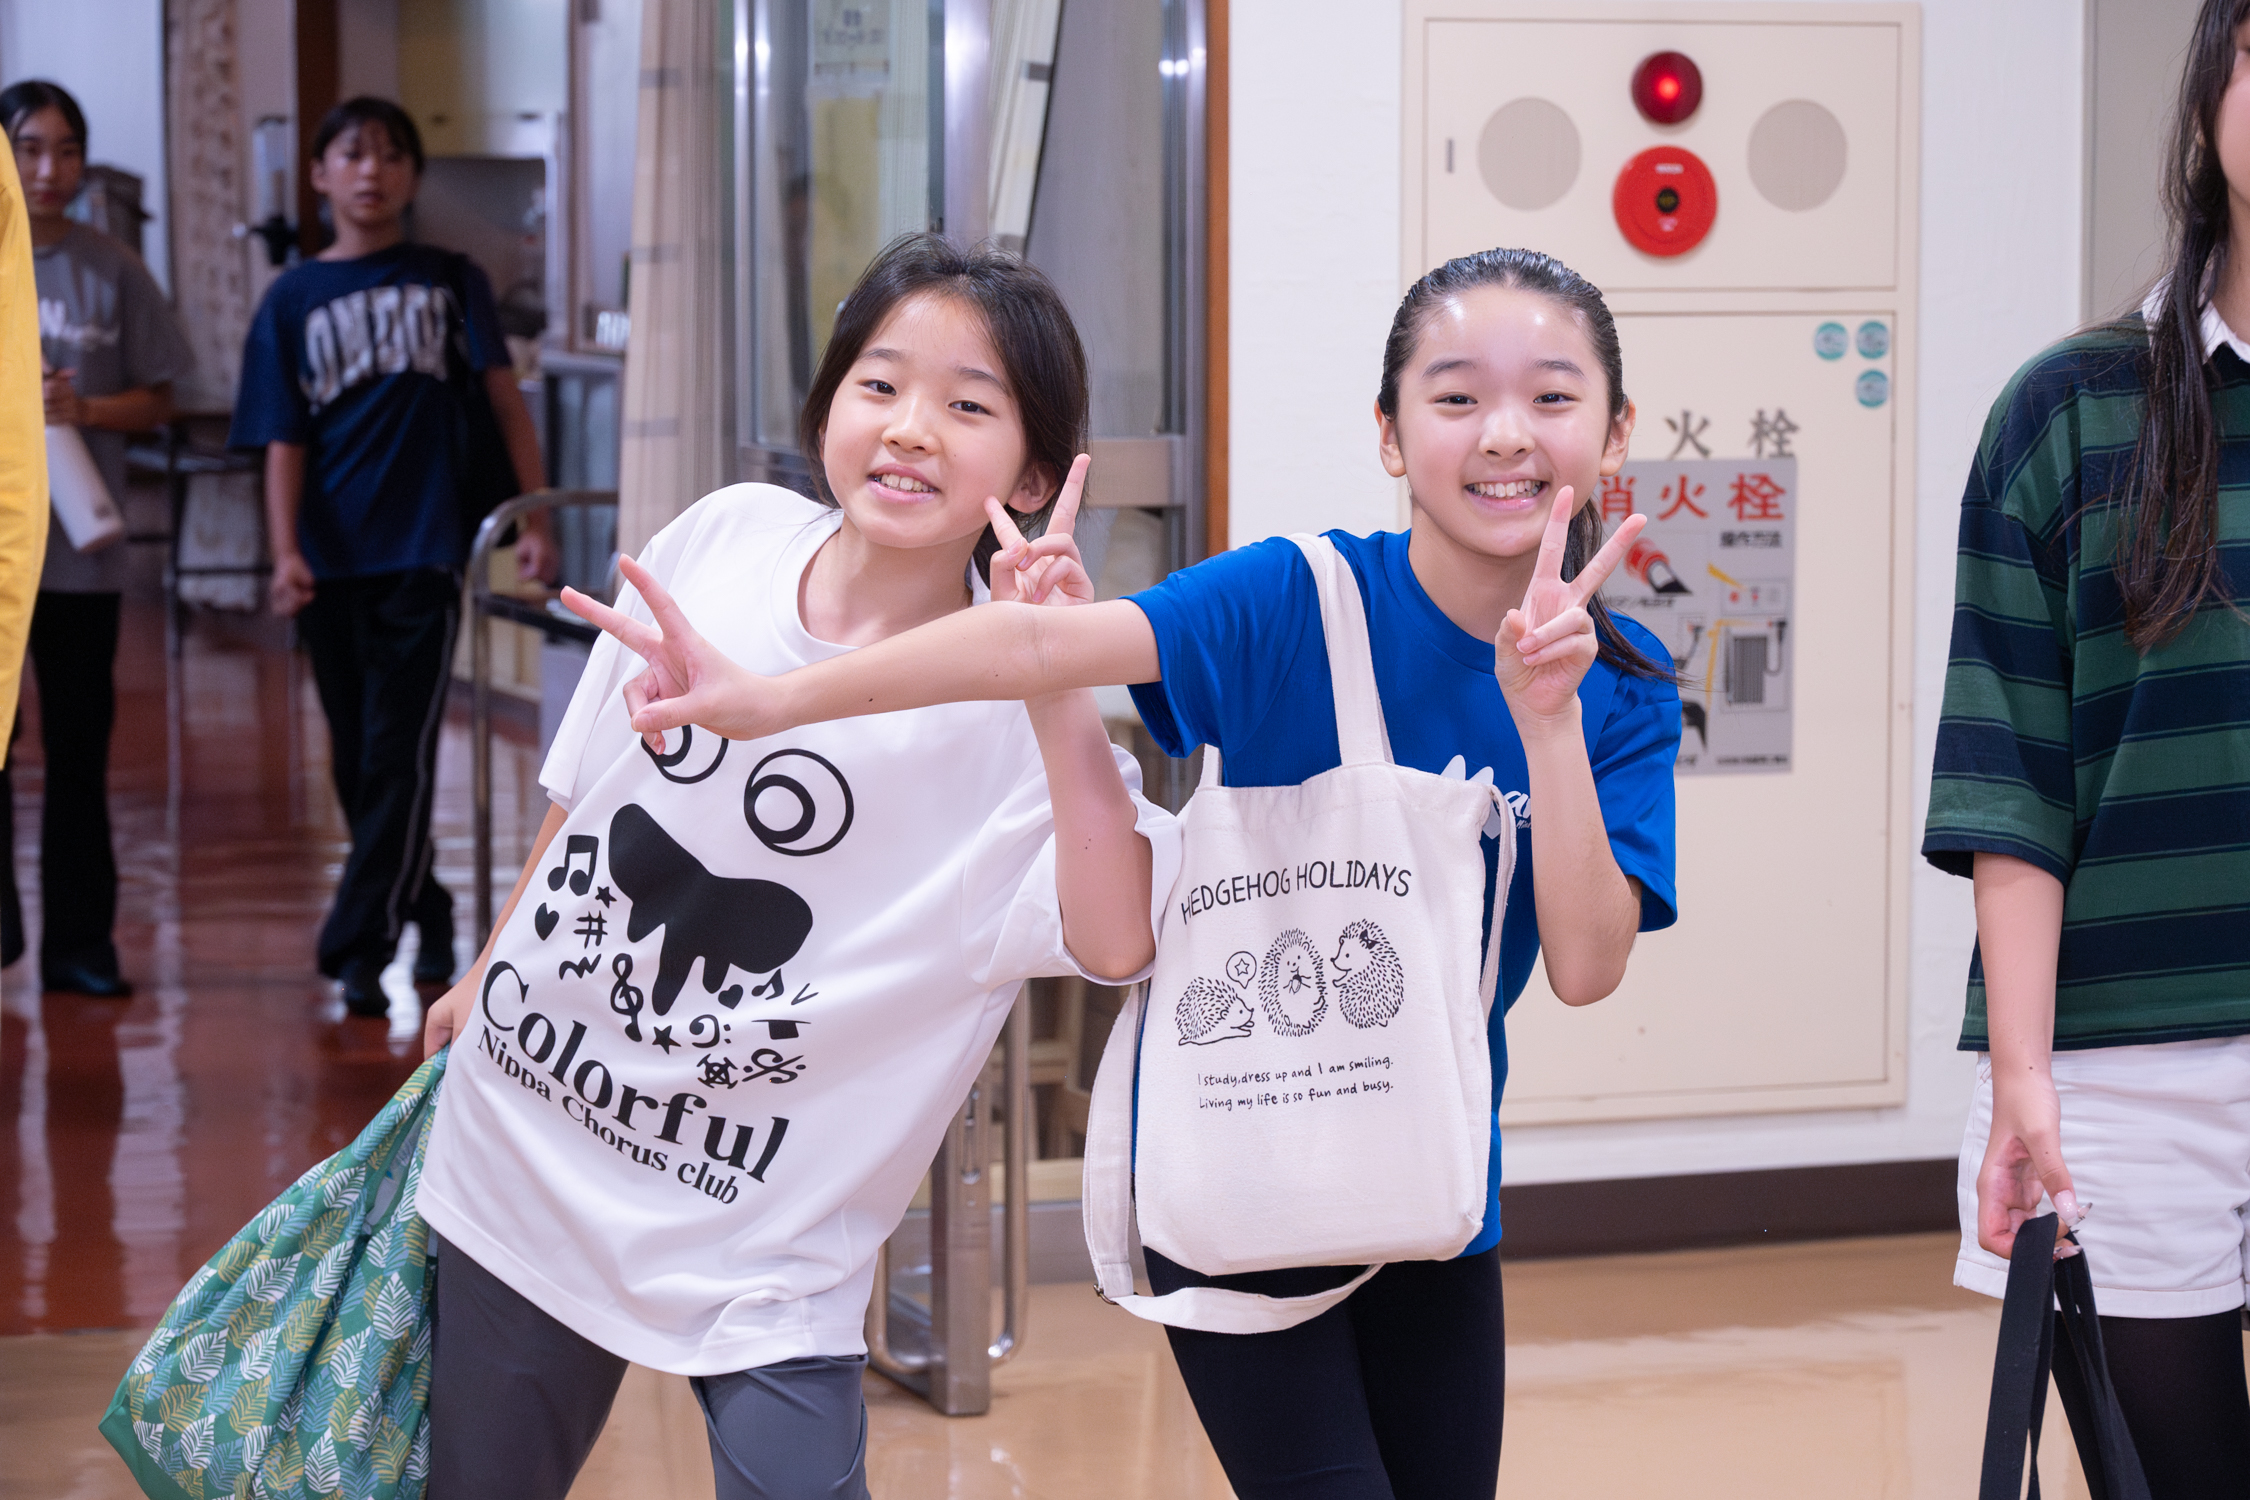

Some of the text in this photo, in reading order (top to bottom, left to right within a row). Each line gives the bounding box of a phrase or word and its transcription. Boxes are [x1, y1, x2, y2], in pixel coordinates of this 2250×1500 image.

[1180, 859, 1412, 925] HEDGEHOG HOLIDAYS
[481, 960, 790, 1184] Colorful
[1199, 1079, 1395, 1112] Living my life is so fun and busy.
[1275, 1071, 1288, 1083] up
[1291, 1065, 1313, 1078] and
[1317, 1062, 1323, 1075] I
[1328, 1065, 1346, 1074] am
[1348, 1055, 1394, 1072] smiling.
[477, 1024, 740, 1205] Nippa Chorus club
